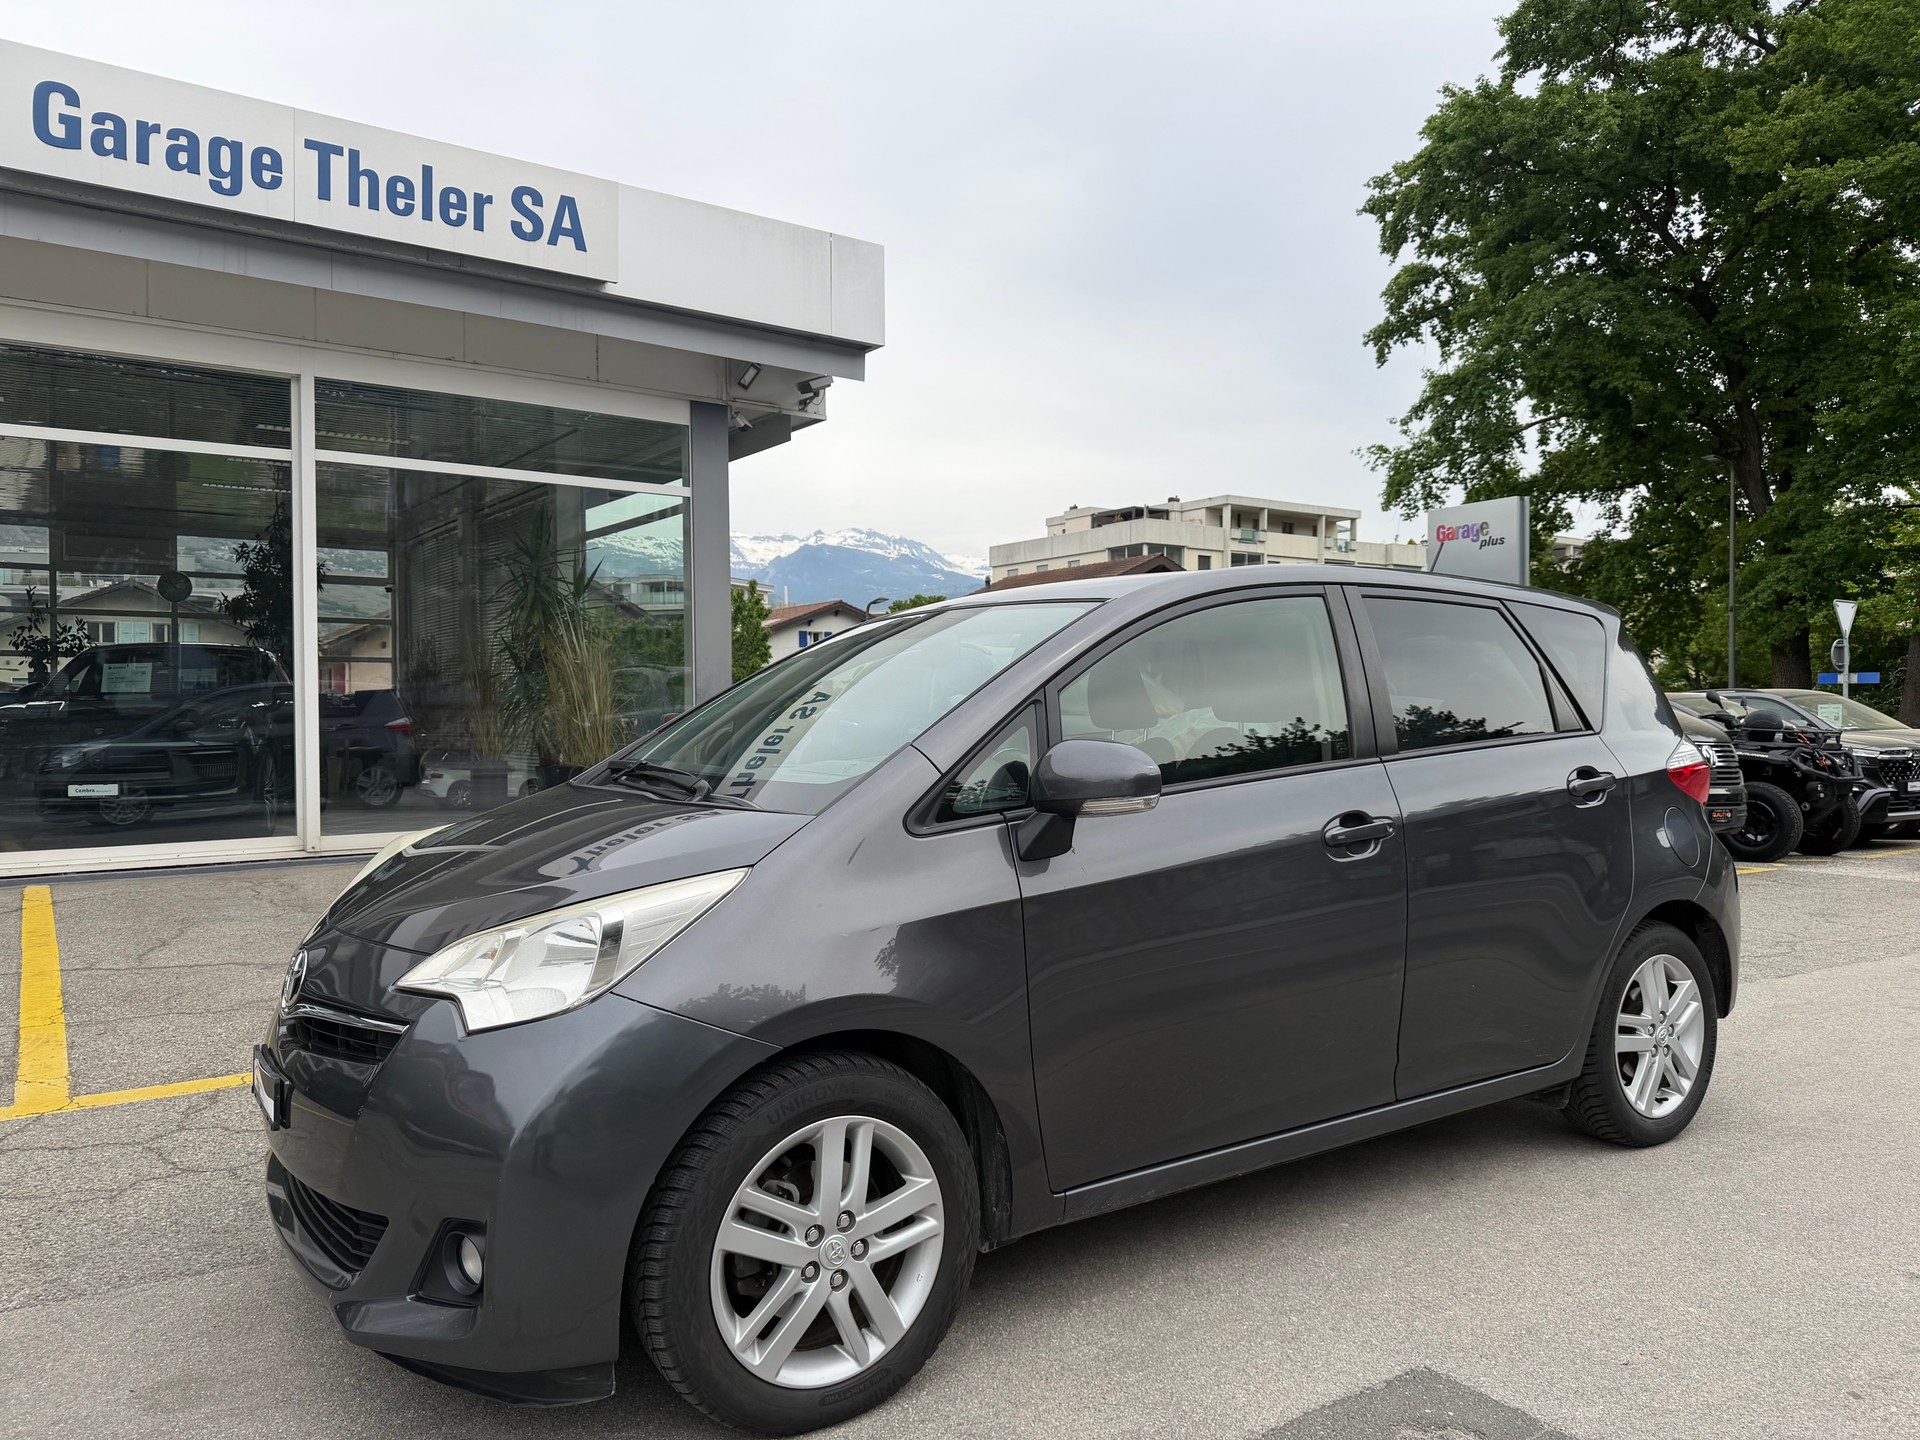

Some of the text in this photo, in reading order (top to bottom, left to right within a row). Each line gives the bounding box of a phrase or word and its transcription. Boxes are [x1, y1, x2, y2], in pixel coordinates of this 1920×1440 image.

[33, 80, 588, 254] Garage Theler SA
[1436, 520, 1490, 543] Garage
[1479, 535, 1506, 550] plus
[766, 1080, 861, 1125] UNIROYAL
